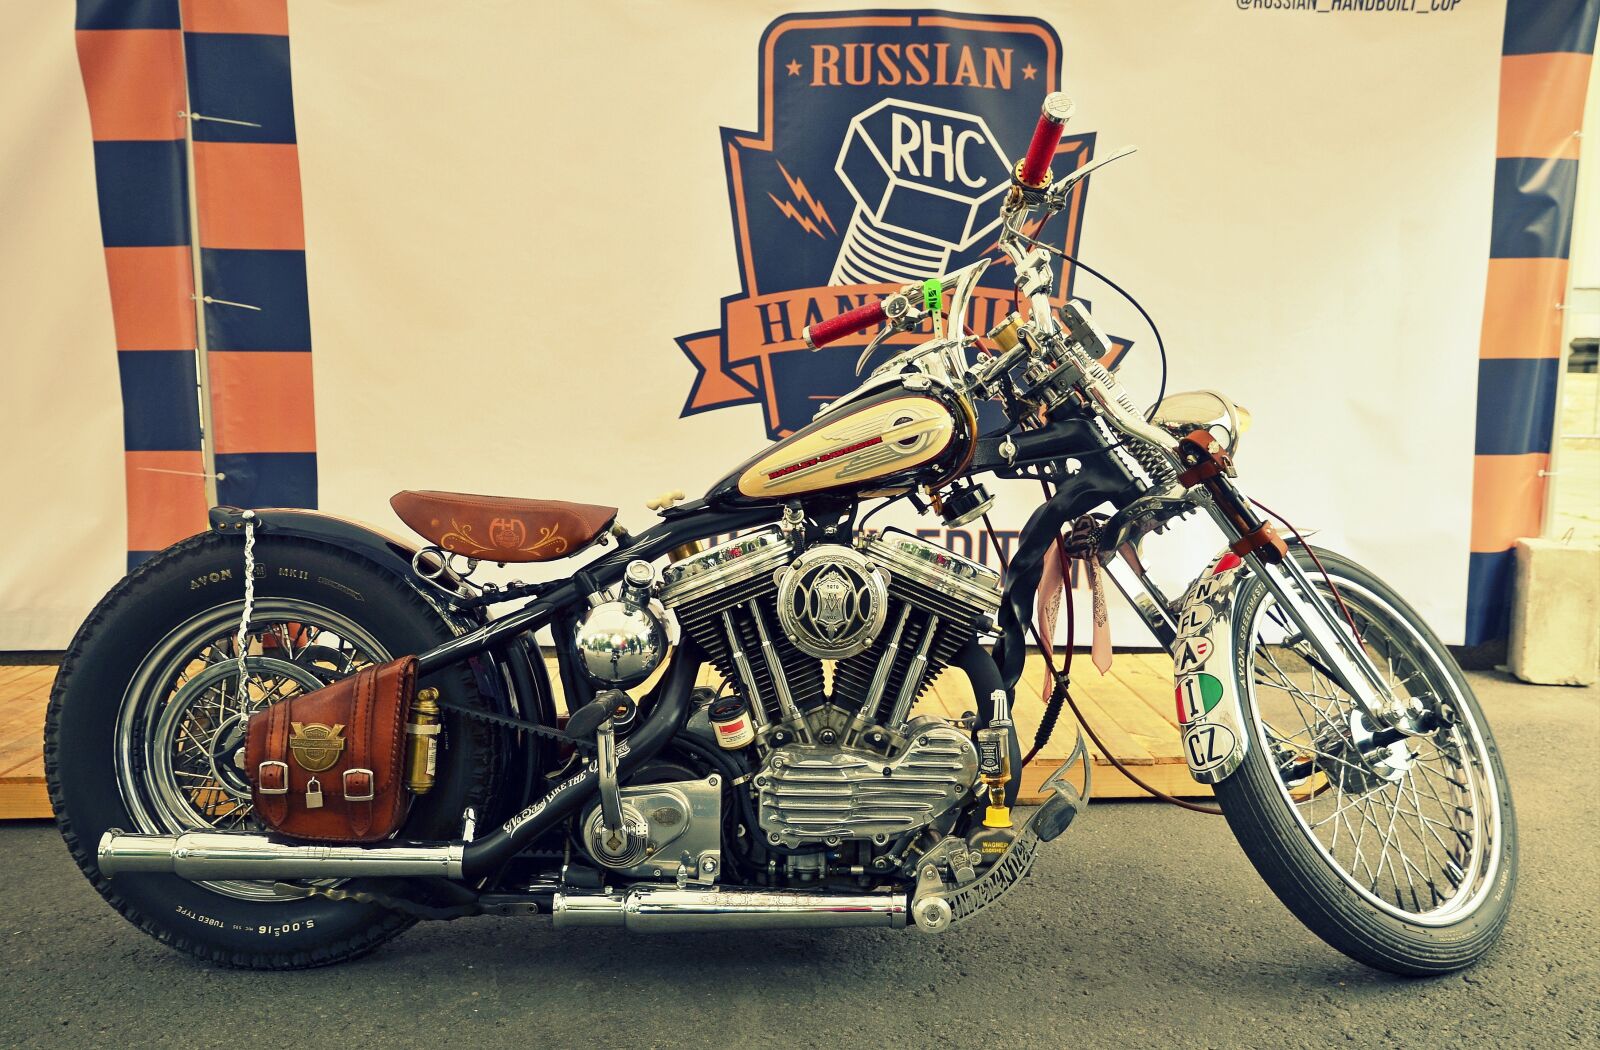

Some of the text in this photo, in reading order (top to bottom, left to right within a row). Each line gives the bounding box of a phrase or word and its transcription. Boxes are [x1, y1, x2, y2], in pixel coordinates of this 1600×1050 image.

[809, 43, 1014, 90] RUSSIAN
[891, 112, 987, 189] RHC
[190, 568, 232, 590] AVON
[1181, 610, 1203, 635] FL
[1180, 641, 1198, 671] A
[1237, 647, 1247, 689] AVON
[1185, 678, 1199, 718] I
[1188, 726, 1224, 767] CZ
[545, 782, 567, 803] LIKE
[567, 770, 587, 787] THE
[175, 905, 197, 920] TYPE
[197, 914, 225, 928] TUBED
